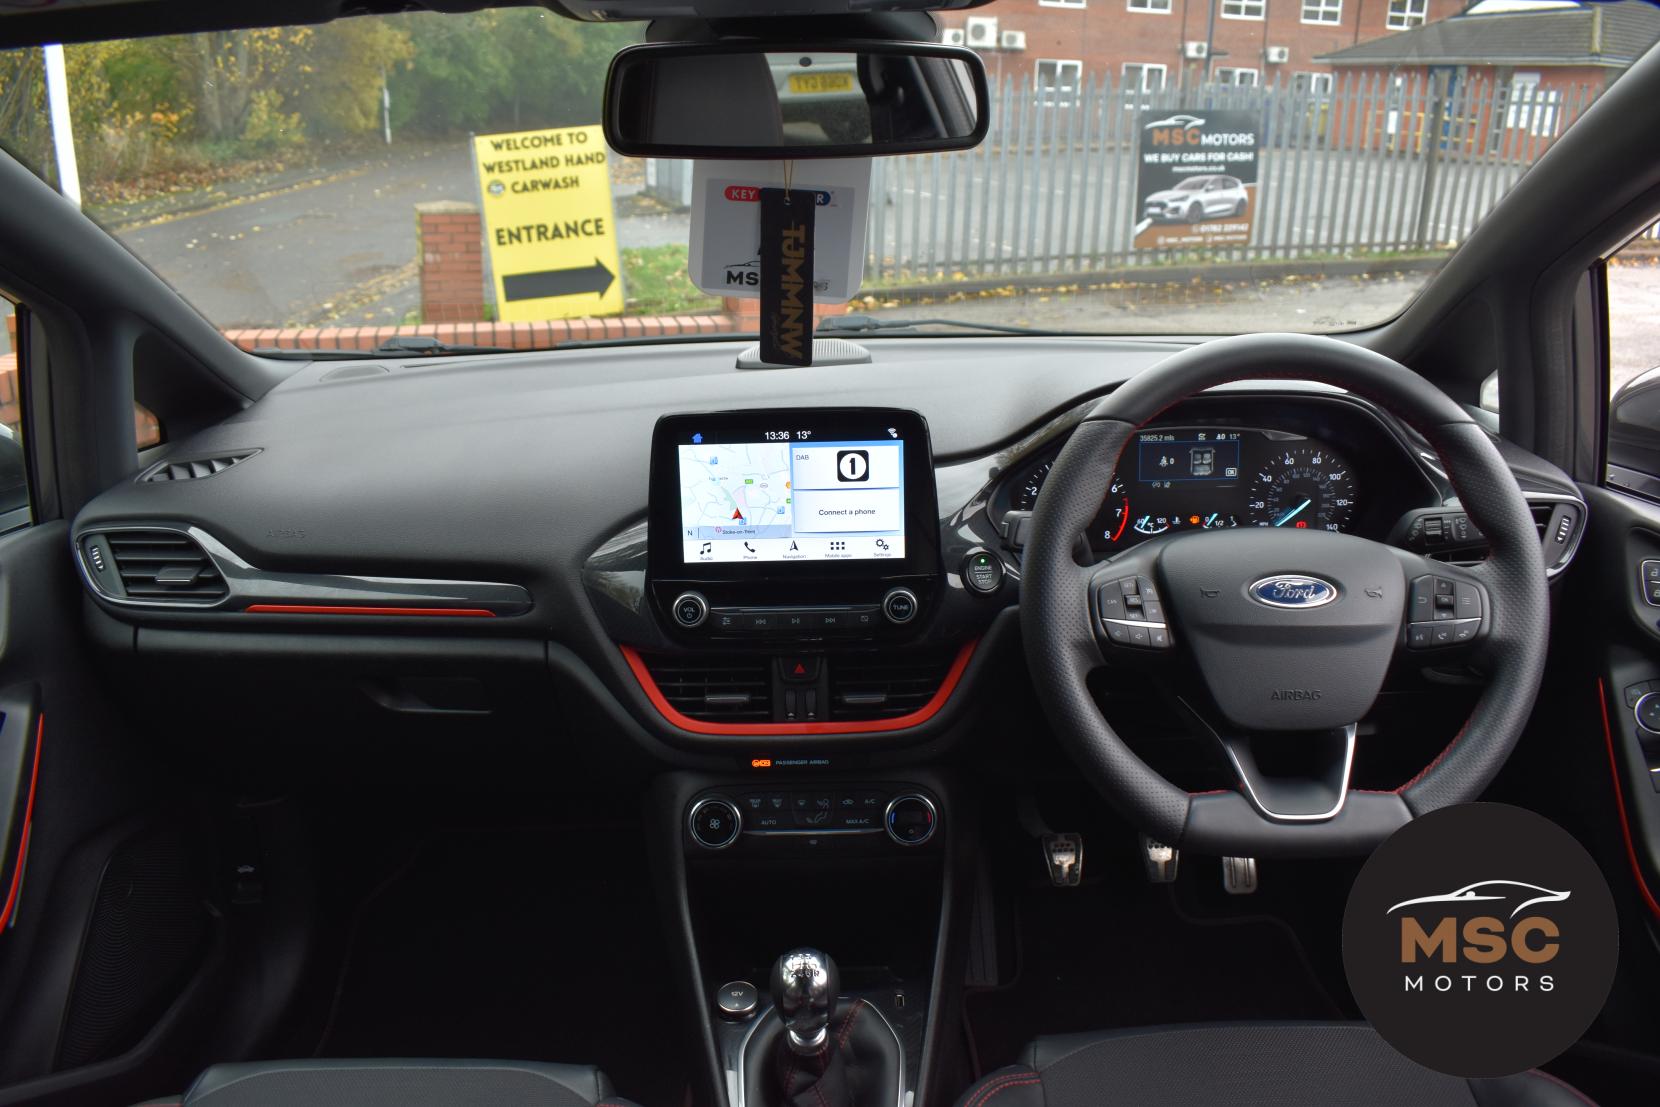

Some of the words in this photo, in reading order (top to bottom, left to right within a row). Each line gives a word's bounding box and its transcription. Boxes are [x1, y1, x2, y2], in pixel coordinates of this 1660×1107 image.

[491, 133, 563, 151] WELCOME
[567, 131, 588, 144] TO
[1152, 128, 1200, 145] MSC
[1201, 133, 1255, 146] MOTORS
[482, 155, 560, 174] WESTLAND
[565, 152, 606, 166] HAND
[1144, 153, 1159, 163] WE
[1160, 153, 1181, 162] BUY
[1181, 152, 1206, 162] CARS
[1207, 152, 1226, 161] FOR
[511, 176, 580, 194] CARWASH
[731, 188, 756, 200] KEY
[495, 218, 605, 246] ENTRANCE
[726, 270, 760, 286] MS
[765, 431, 790, 440] 13:36
[1329, 473, 1341, 481] 100
[1031, 486, 1037, 496] 2
[1111, 484, 1118, 493] 6
[1255, 501, 1264, 509] 20
[854, 508, 876, 516] phone
[1115, 509, 1122, 518] 7
[1104, 531, 1111, 539] 8
[1273, 581, 1316, 599] Ford
[1271, 690, 1321, 701] AIRBAG
